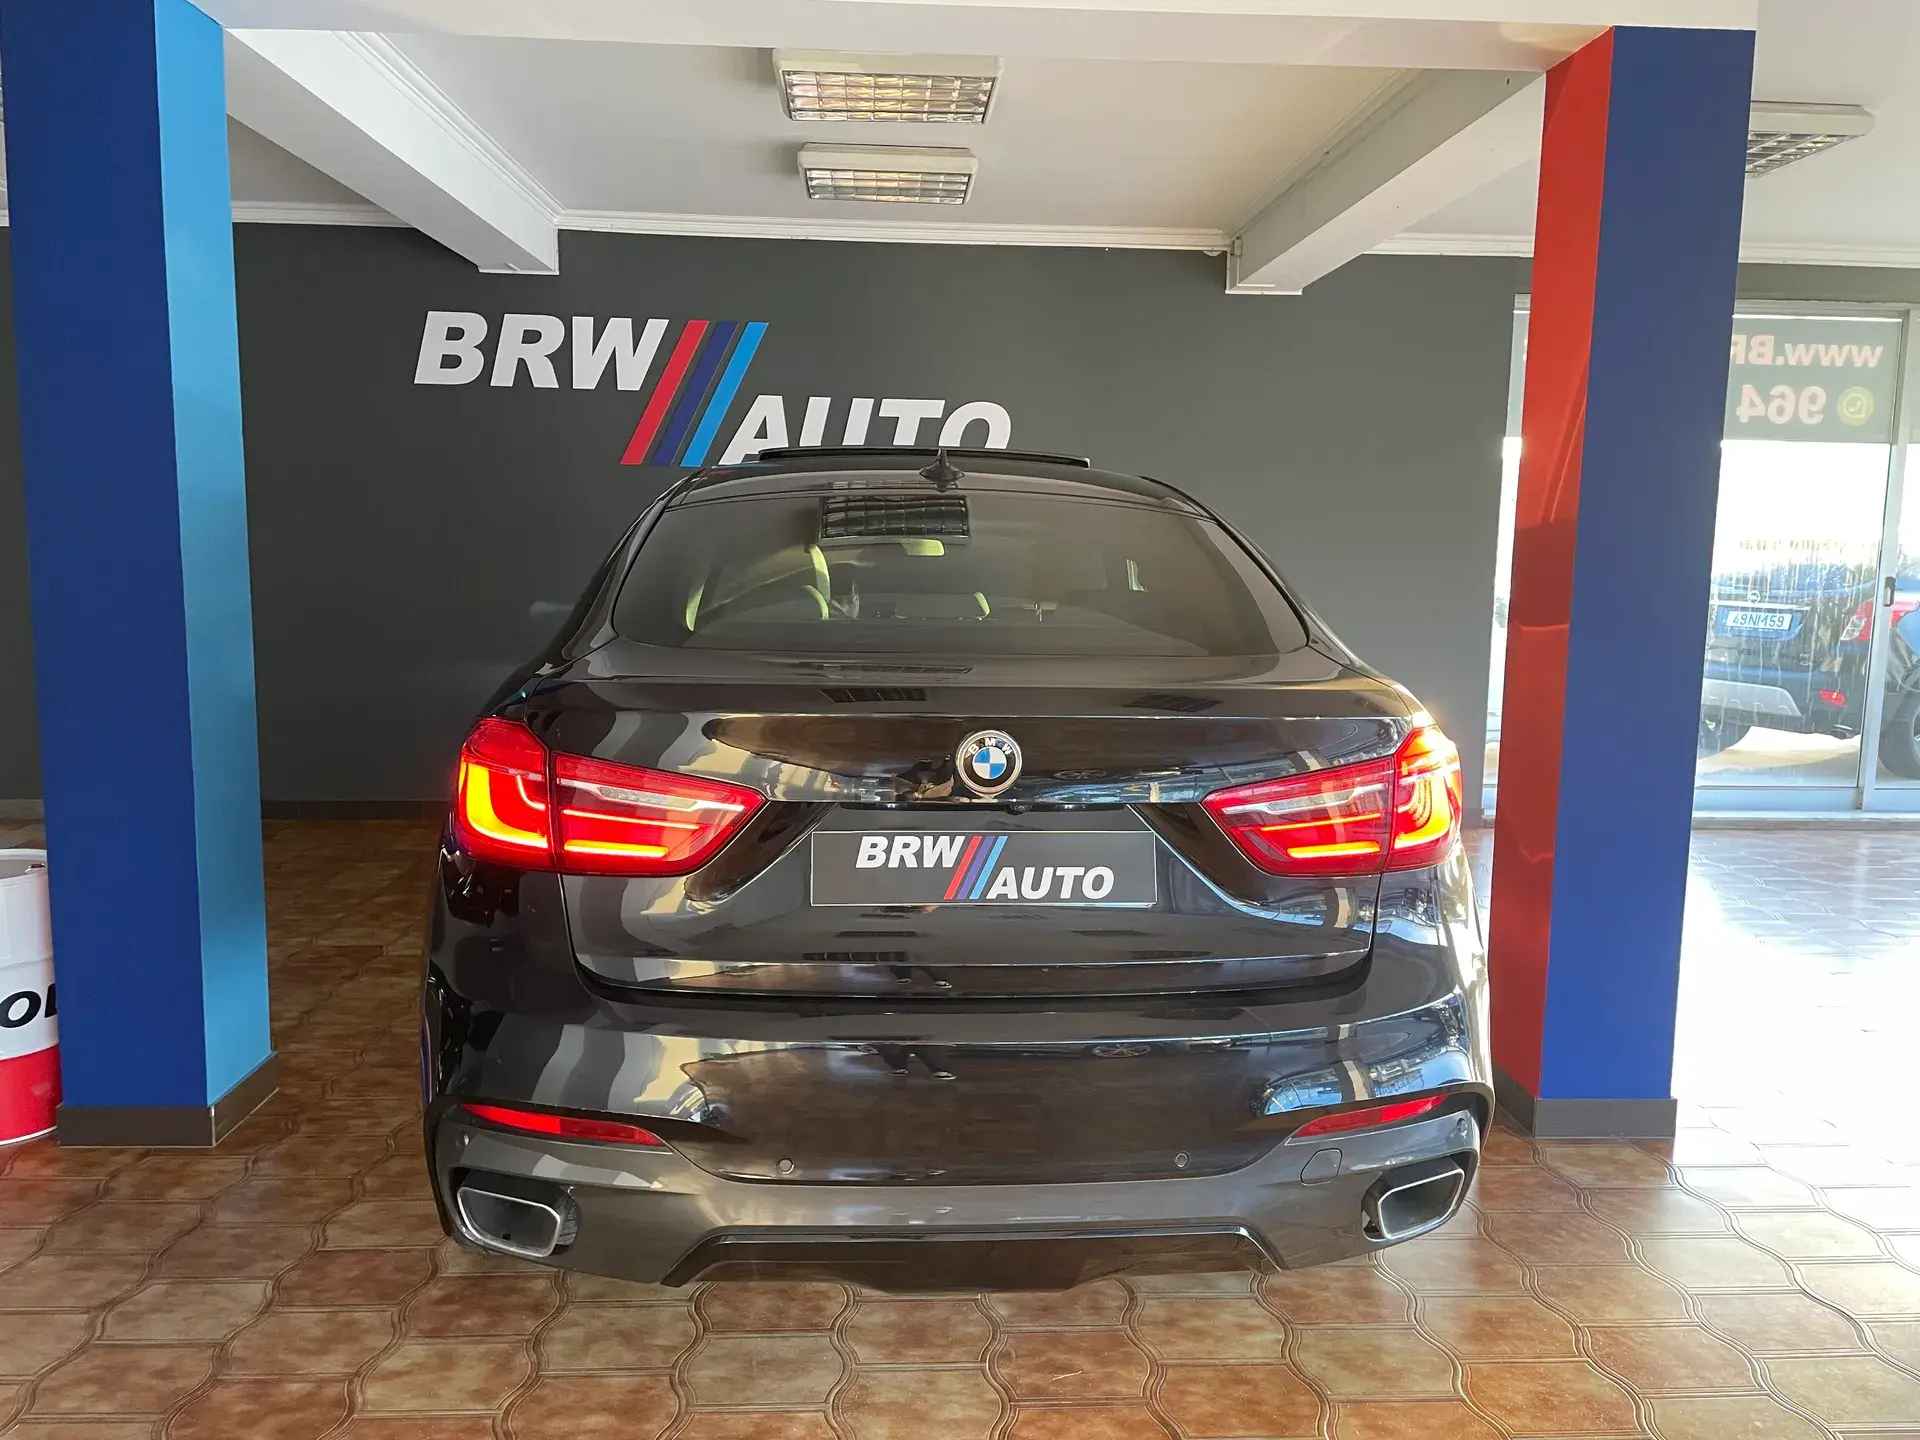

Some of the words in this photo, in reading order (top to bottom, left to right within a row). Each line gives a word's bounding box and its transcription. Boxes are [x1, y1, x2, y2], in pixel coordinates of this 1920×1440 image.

[413, 310, 670, 391] BRW
[718, 394, 1012, 466] AUTO
[967, 737, 1013, 755] BMW
[855, 835, 966, 869] BRW
[985, 866, 1115, 900] AUTO
